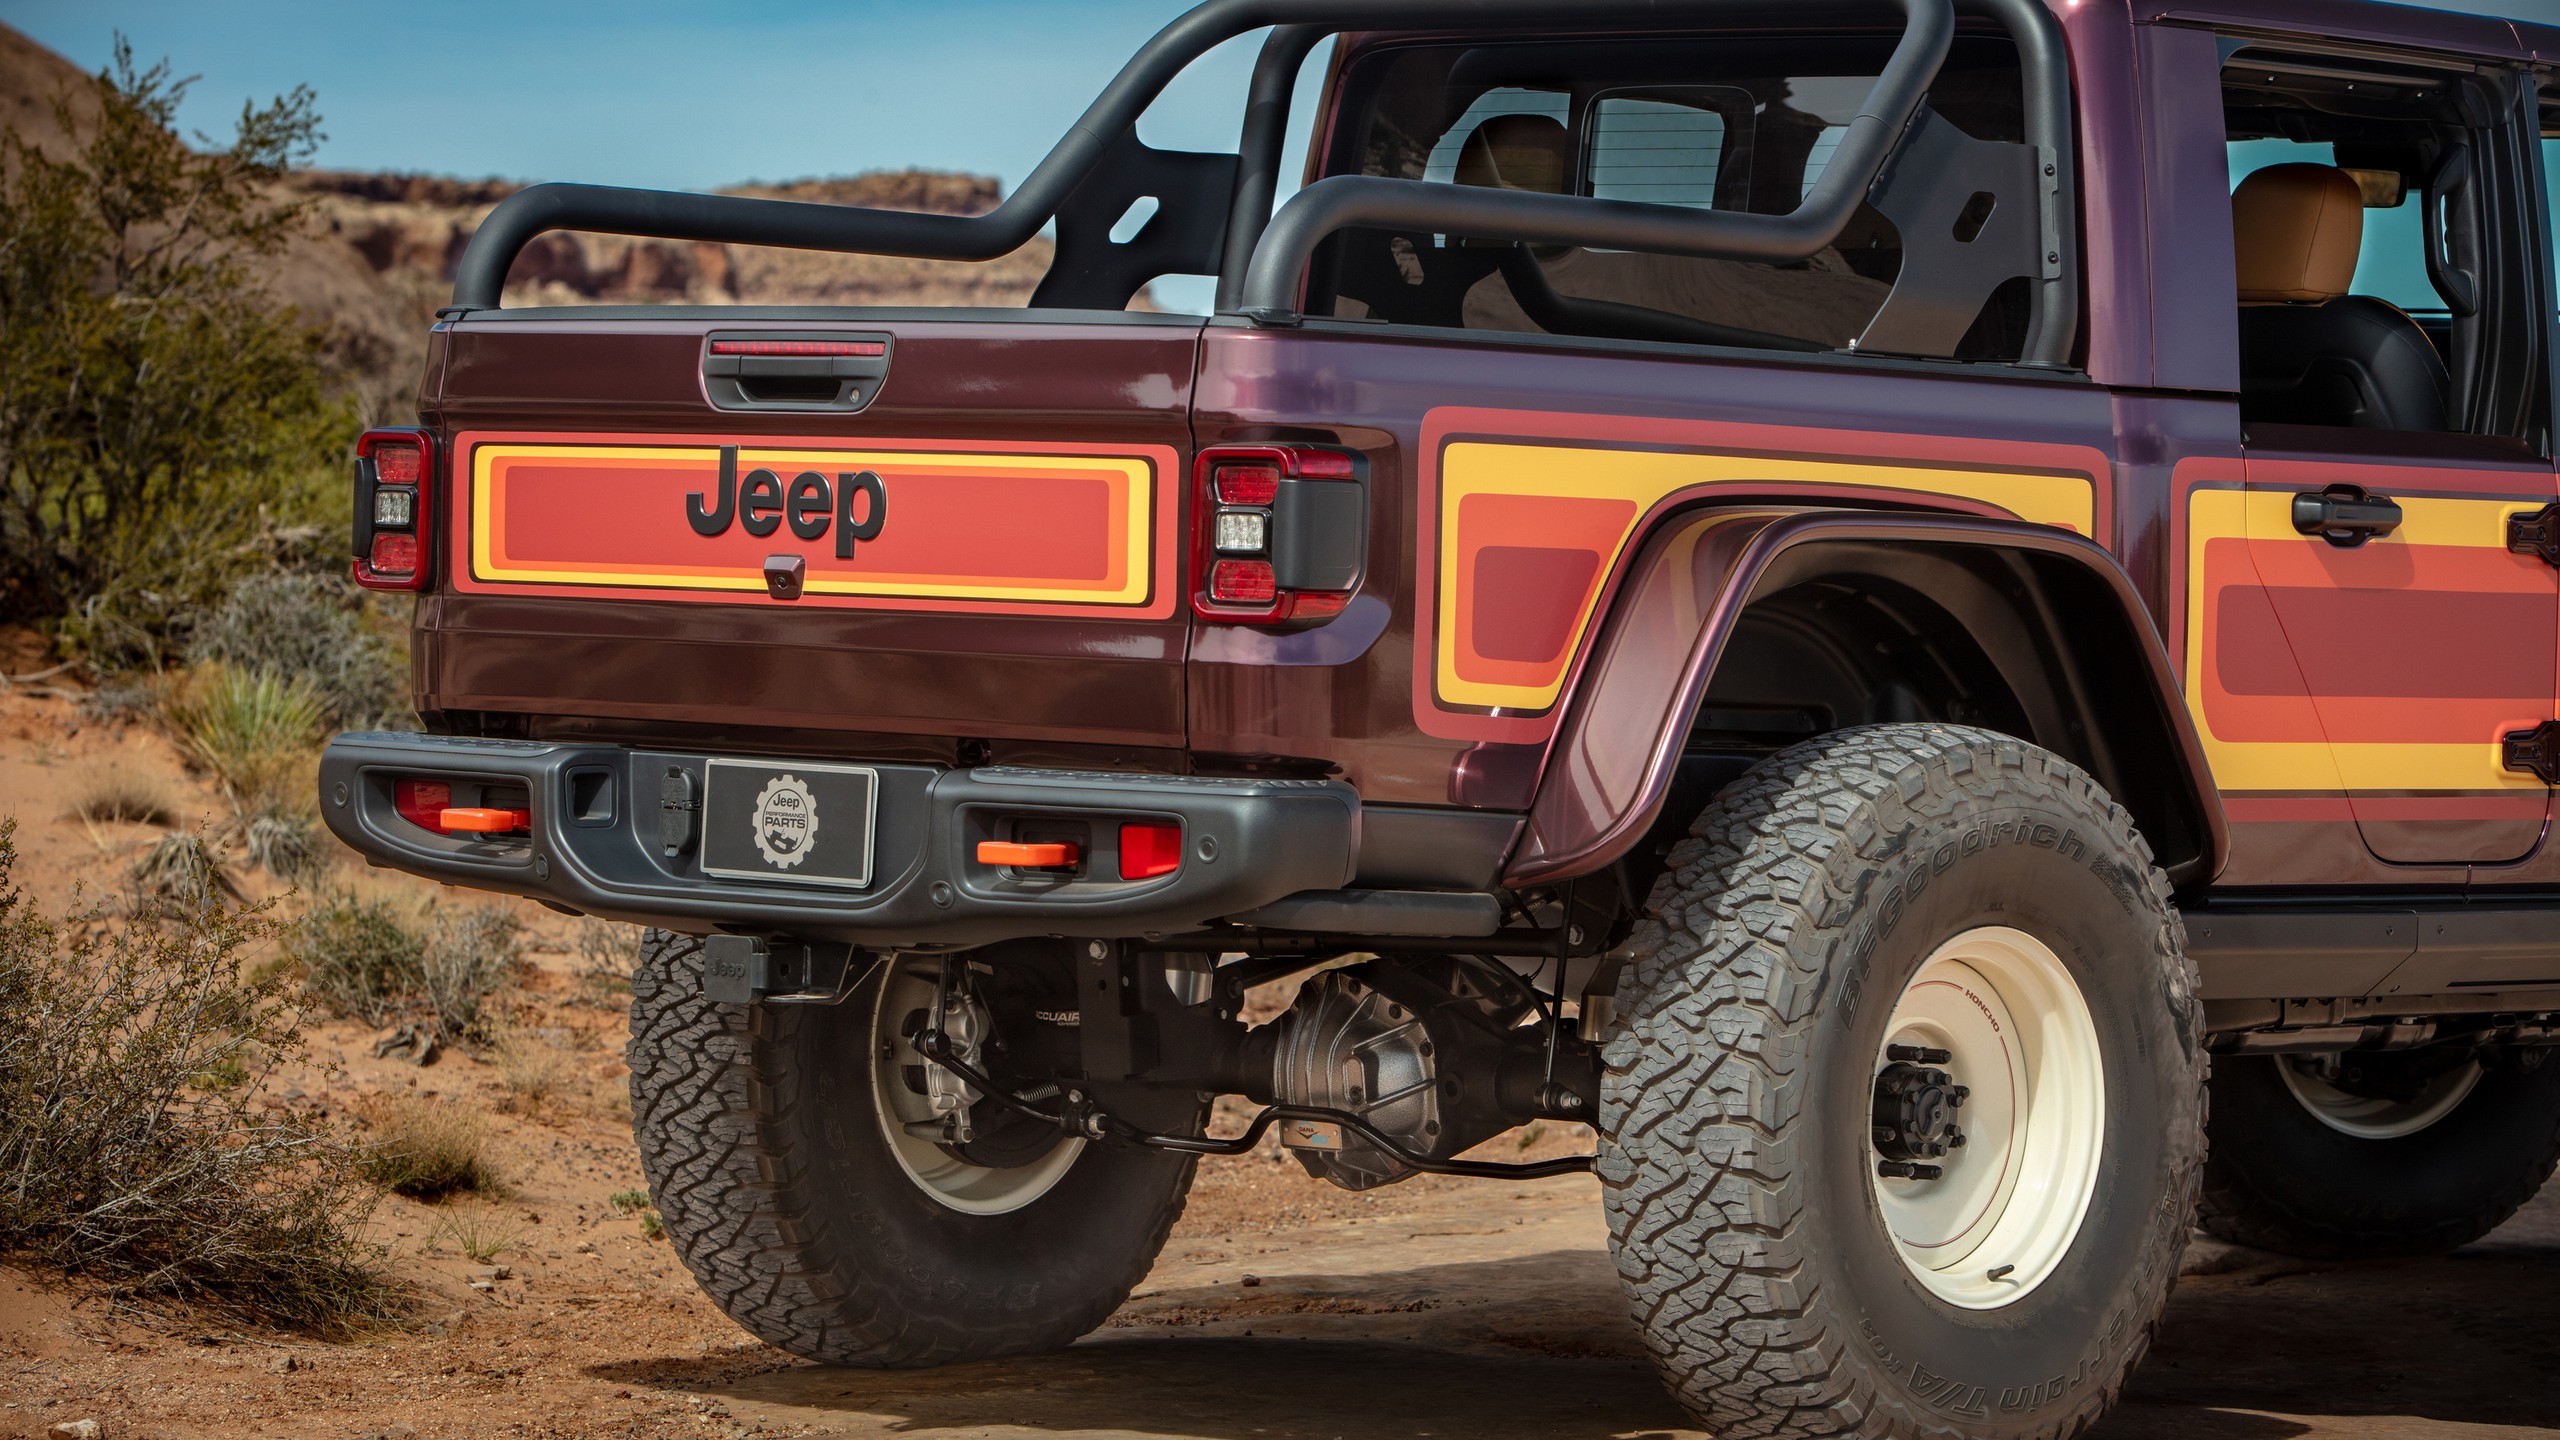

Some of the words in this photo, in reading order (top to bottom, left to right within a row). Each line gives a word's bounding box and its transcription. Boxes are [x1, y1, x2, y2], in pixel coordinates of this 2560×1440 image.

[686, 444, 888, 559] Jeep
[765, 811, 806, 819] PERFORMANCE
[773, 793, 800, 810] Jeep
[765, 816, 806, 829] PARTS
[1836, 815, 2087, 1030] BFGoodrich
[709, 956, 746, 981] Jeep
[1964, 988, 2001, 1034] HONCHO
[1907, 1361, 1988, 1416] T/A
